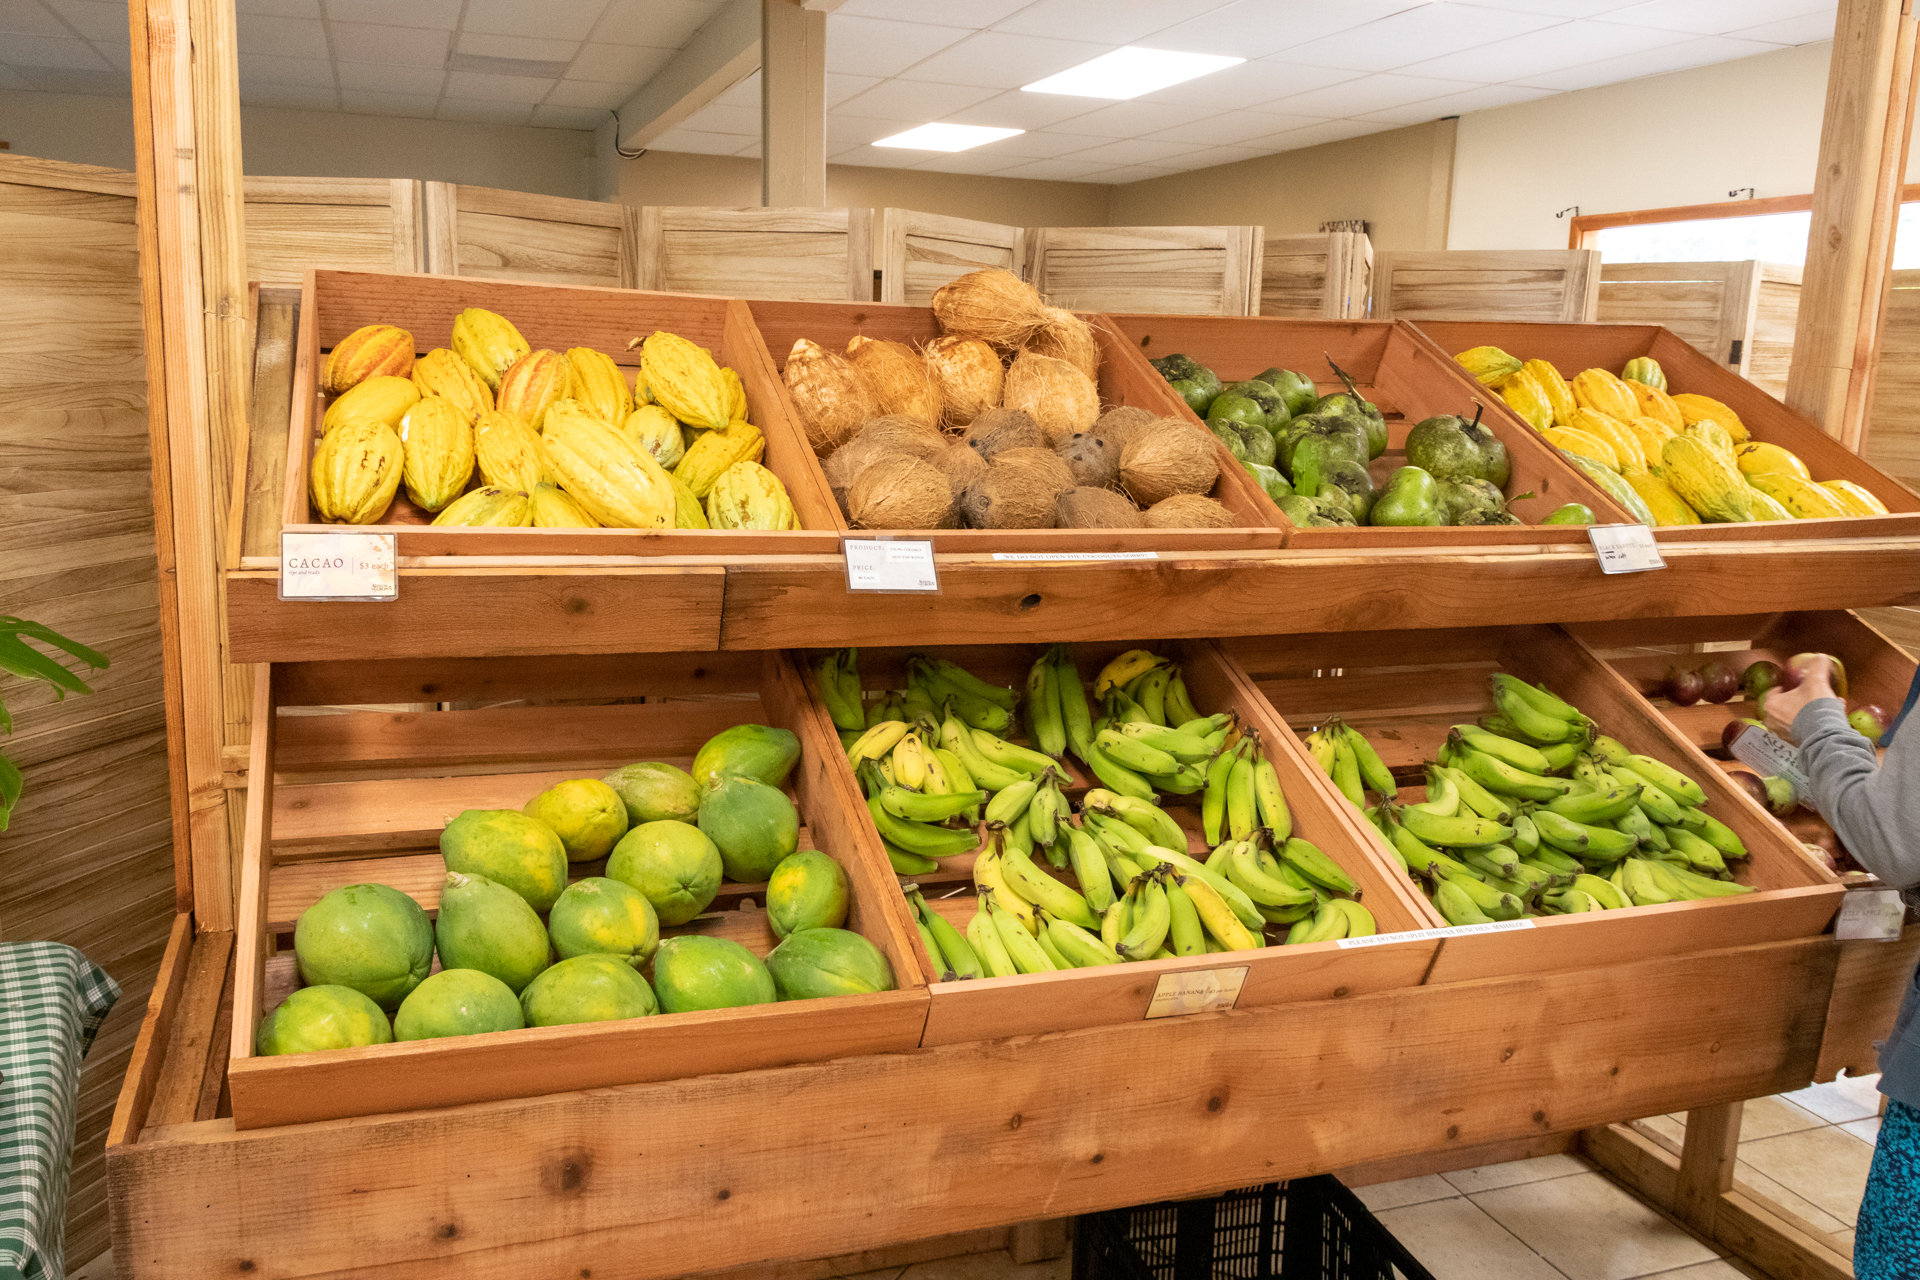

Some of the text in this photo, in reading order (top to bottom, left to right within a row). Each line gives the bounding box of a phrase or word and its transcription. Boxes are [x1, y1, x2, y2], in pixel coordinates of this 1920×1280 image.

[288, 557, 389, 570] CACAO $3 each
[1347, 937, 1377, 946] PLEASE
[1389, 934, 1404, 942] NOT
[1405, 932, 1426, 940] SPLIT
[1426, 929, 1455, 938] BANANA
[1492, 922, 1524, 931] MAHALO!
